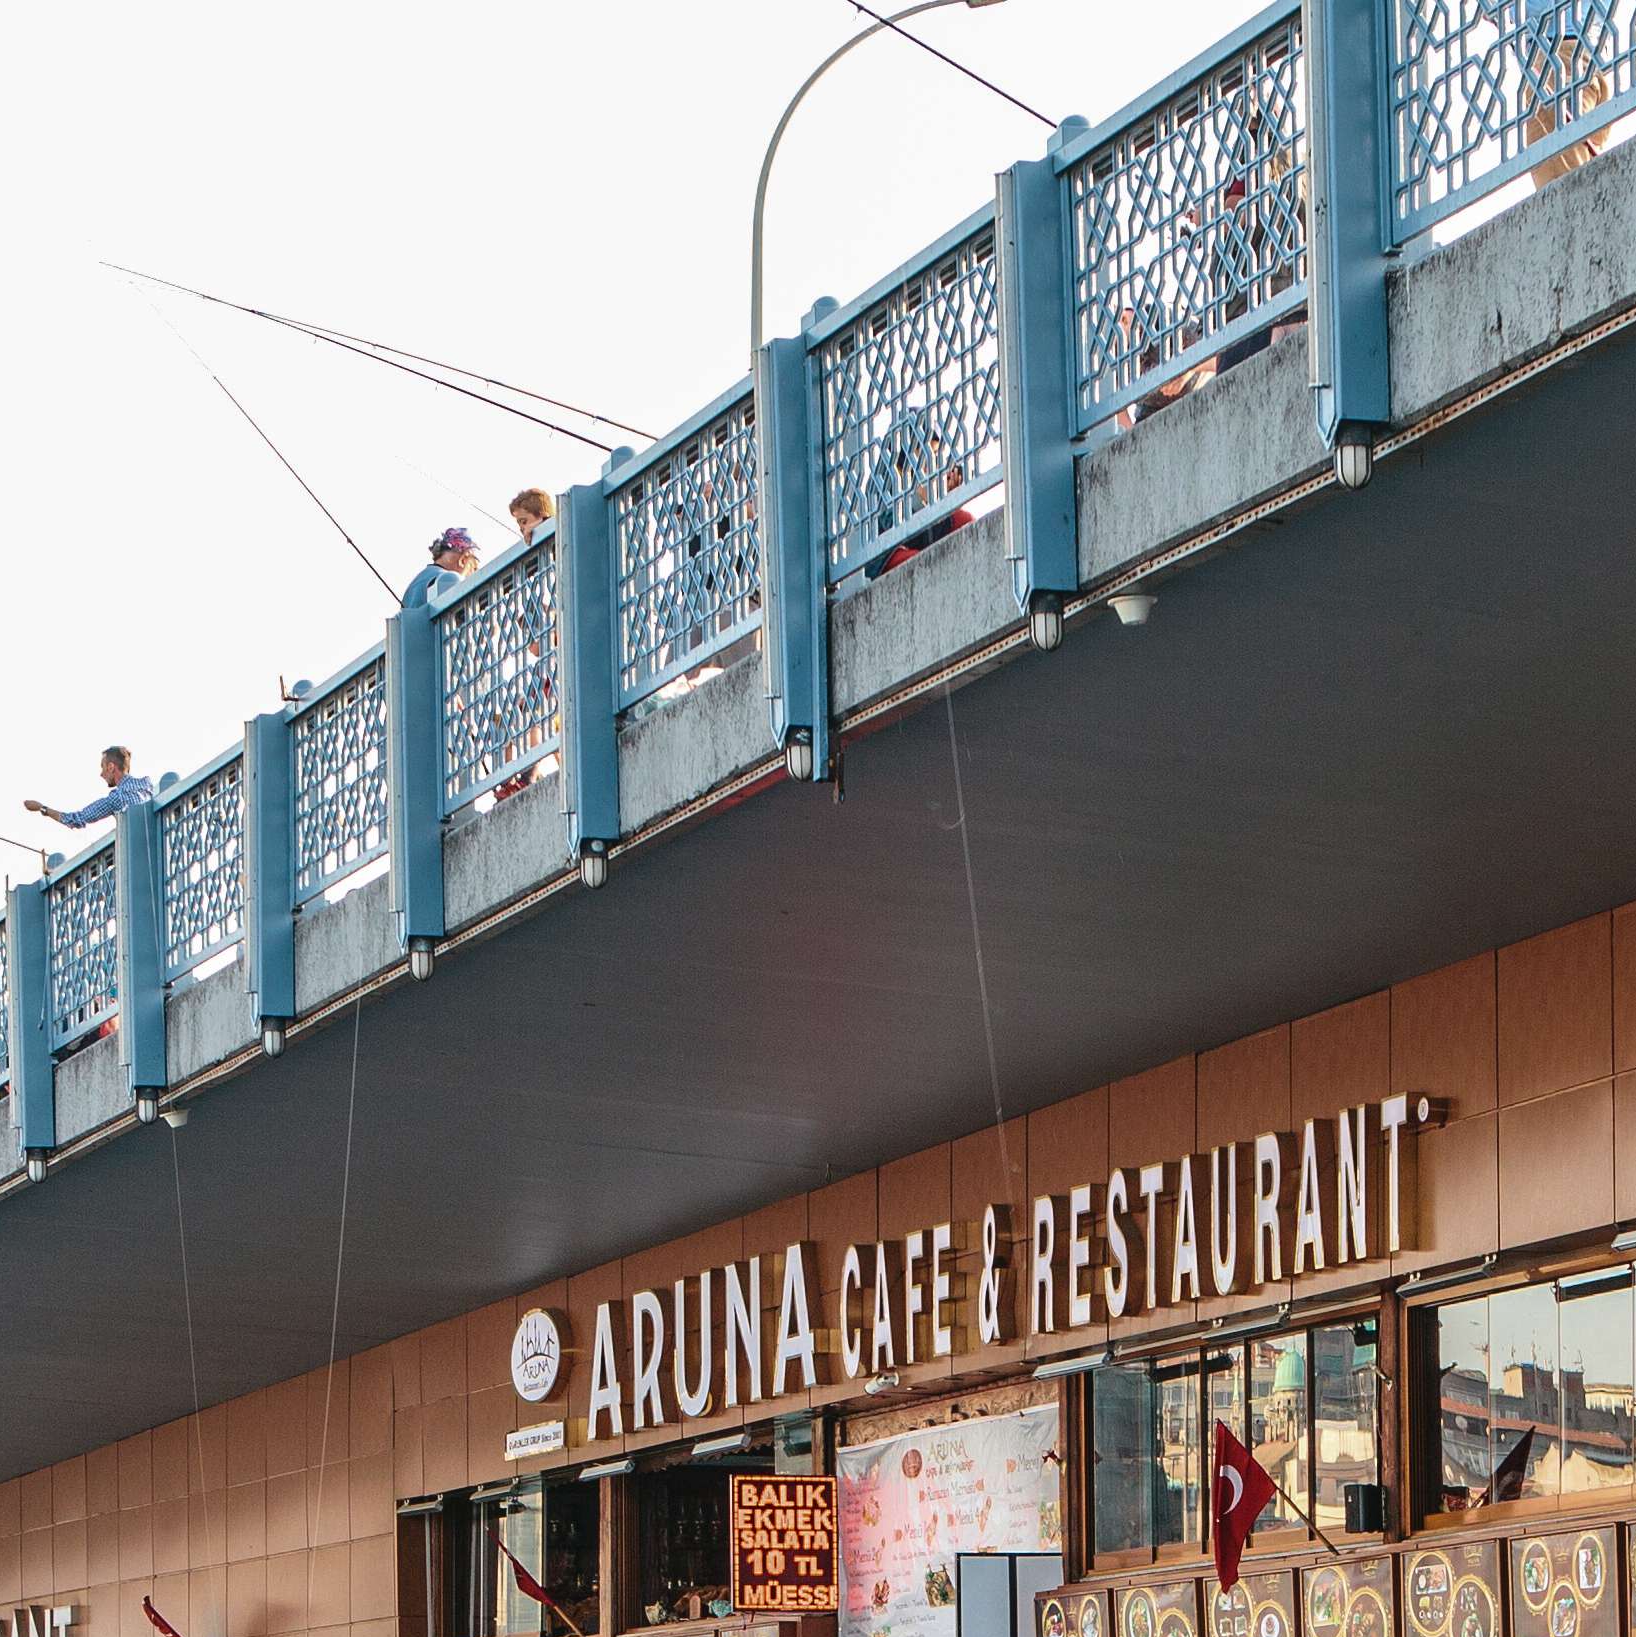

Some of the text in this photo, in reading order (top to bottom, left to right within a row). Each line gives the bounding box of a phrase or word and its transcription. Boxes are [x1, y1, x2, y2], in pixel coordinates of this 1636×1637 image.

[587, 1093, 1409, 1442] ARUNA CAFE & RESTAURANT
[523, 1358, 551, 1379] ARUNA
[927, 1440, 969, 1461] ARUNA
[742, 1484, 827, 1508] BALIK
[738, 1509, 833, 1531] EKMEK
[741, 1530, 829, 1550] SALATA
[747, 1549, 823, 1576] 10 TL
